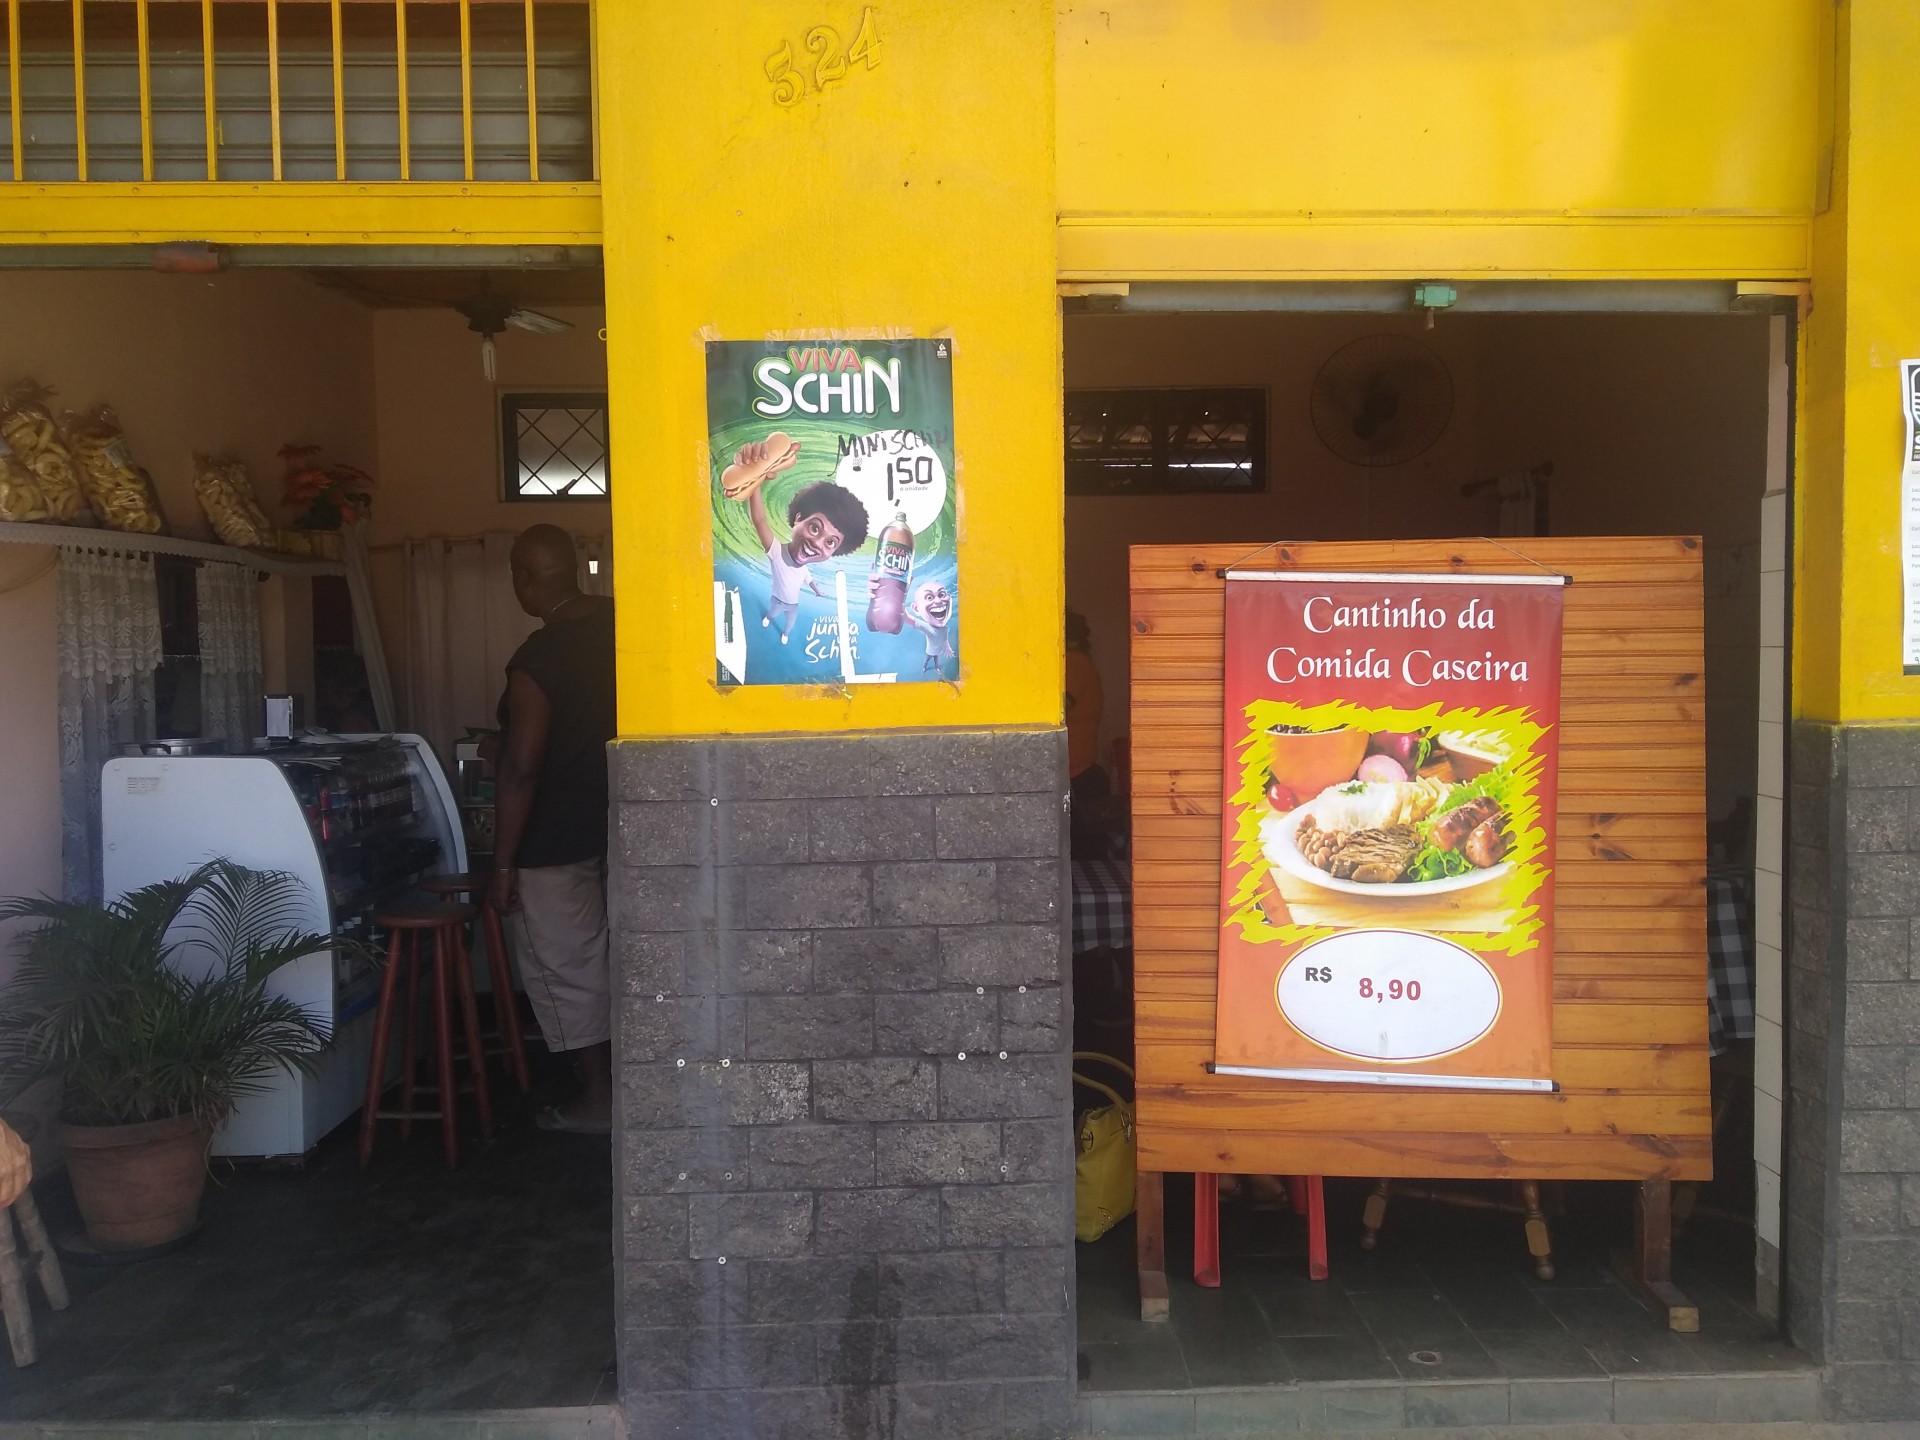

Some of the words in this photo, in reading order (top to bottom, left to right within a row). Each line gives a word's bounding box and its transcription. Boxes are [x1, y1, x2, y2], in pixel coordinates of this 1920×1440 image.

[764, 6, 882, 107] 324
[791, 349, 862, 372] VIVA
[756, 360, 901, 415] SCHIN
[886, 546, 906, 558] VIVA
[1303, 596, 1447, 634] Cantinho
[1457, 598, 1496, 630] da
[805, 618, 860, 642] juno.
[804, 638, 861, 664] Schn.
[1266, 647, 1392, 684] Comida
[1402, 650, 1530, 687] Caseira
[1305, 966, 1333, 983] R$
[1359, 977, 1422, 1004] 8,90
